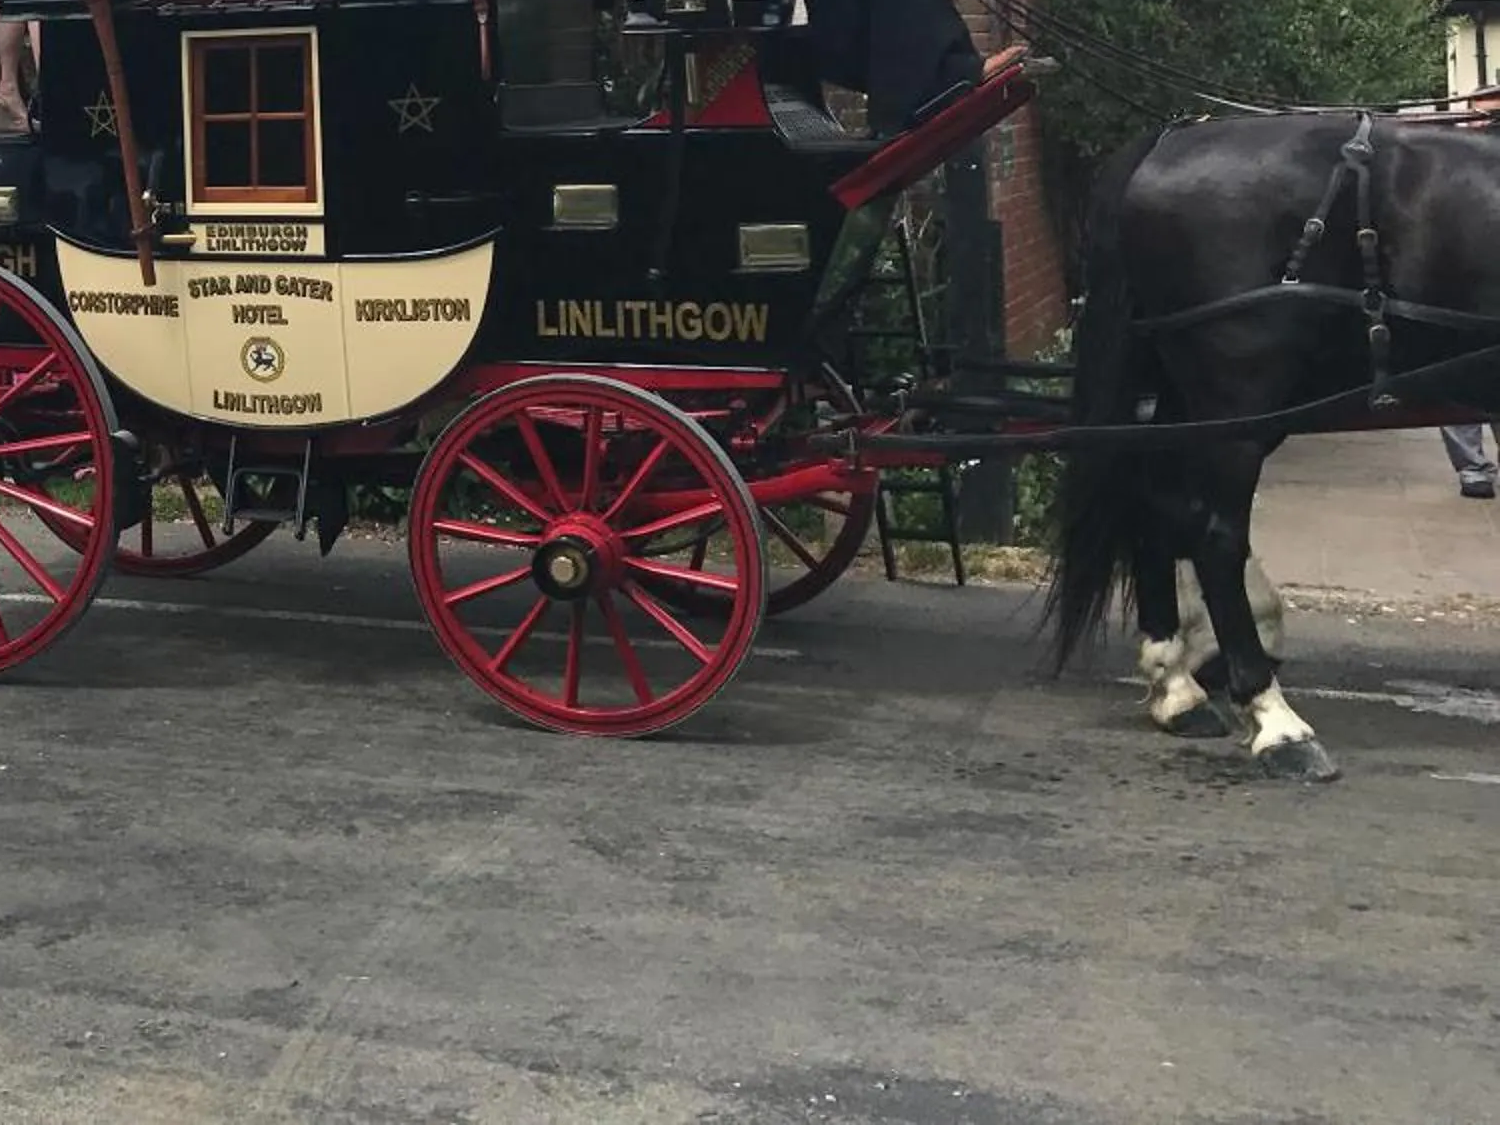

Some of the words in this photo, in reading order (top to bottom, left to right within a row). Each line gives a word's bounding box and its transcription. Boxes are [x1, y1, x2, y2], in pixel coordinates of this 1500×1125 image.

[205, 225, 308, 238] EDINBURGH
[206, 238, 307, 251] LINLITHGOW
[188, 275, 232, 299] STAR
[235, 274, 271, 294] AND
[69, 290, 180, 317] CORSTORPHINE
[232, 304, 288, 325] HOTEL
[355, 298, 470, 321] KIRKLISTON
[536, 299, 769, 342] LINLITHGOW
[213, 389, 322, 415] LINLITHGOW
